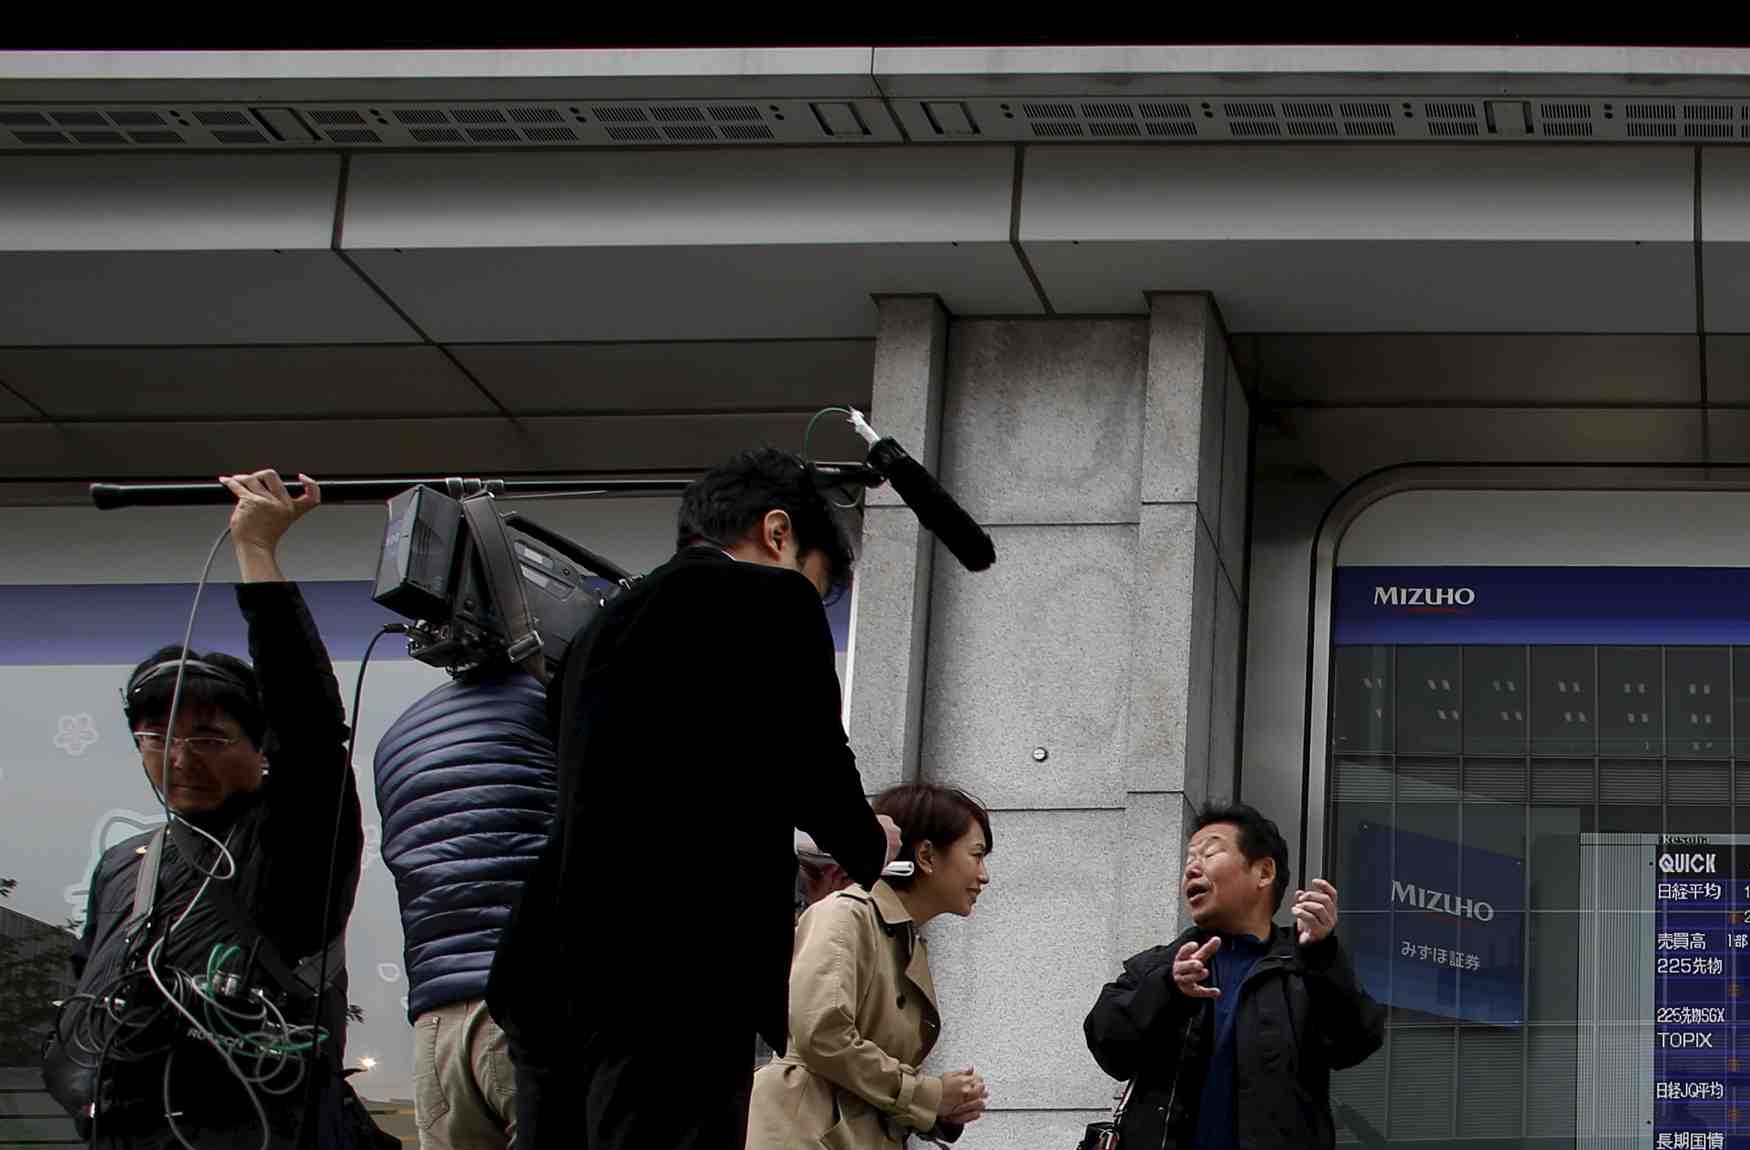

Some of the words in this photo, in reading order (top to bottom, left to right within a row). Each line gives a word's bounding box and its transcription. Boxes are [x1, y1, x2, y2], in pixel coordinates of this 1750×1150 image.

[1374, 586, 1475, 606] MIZUHO
[1658, 853, 1716, 873] QUICK
[1658, 883, 1721, 900] 日経平均
[1391, 879, 1495, 924] MIZUHO
[1657, 933, 1706, 950] 売買高
[1400, 939, 1481, 972] みずほ証券
[1658, 958, 1722, 975] 225先物
[1657, 1008, 1725, 1024] 225先物SGX
[1660, 1033, 1712, 1048] TOPIX
[1656, 1082, 1723, 1099] 日経JQ平均
[1656, 1133, 1724, 1150] 長期国債
